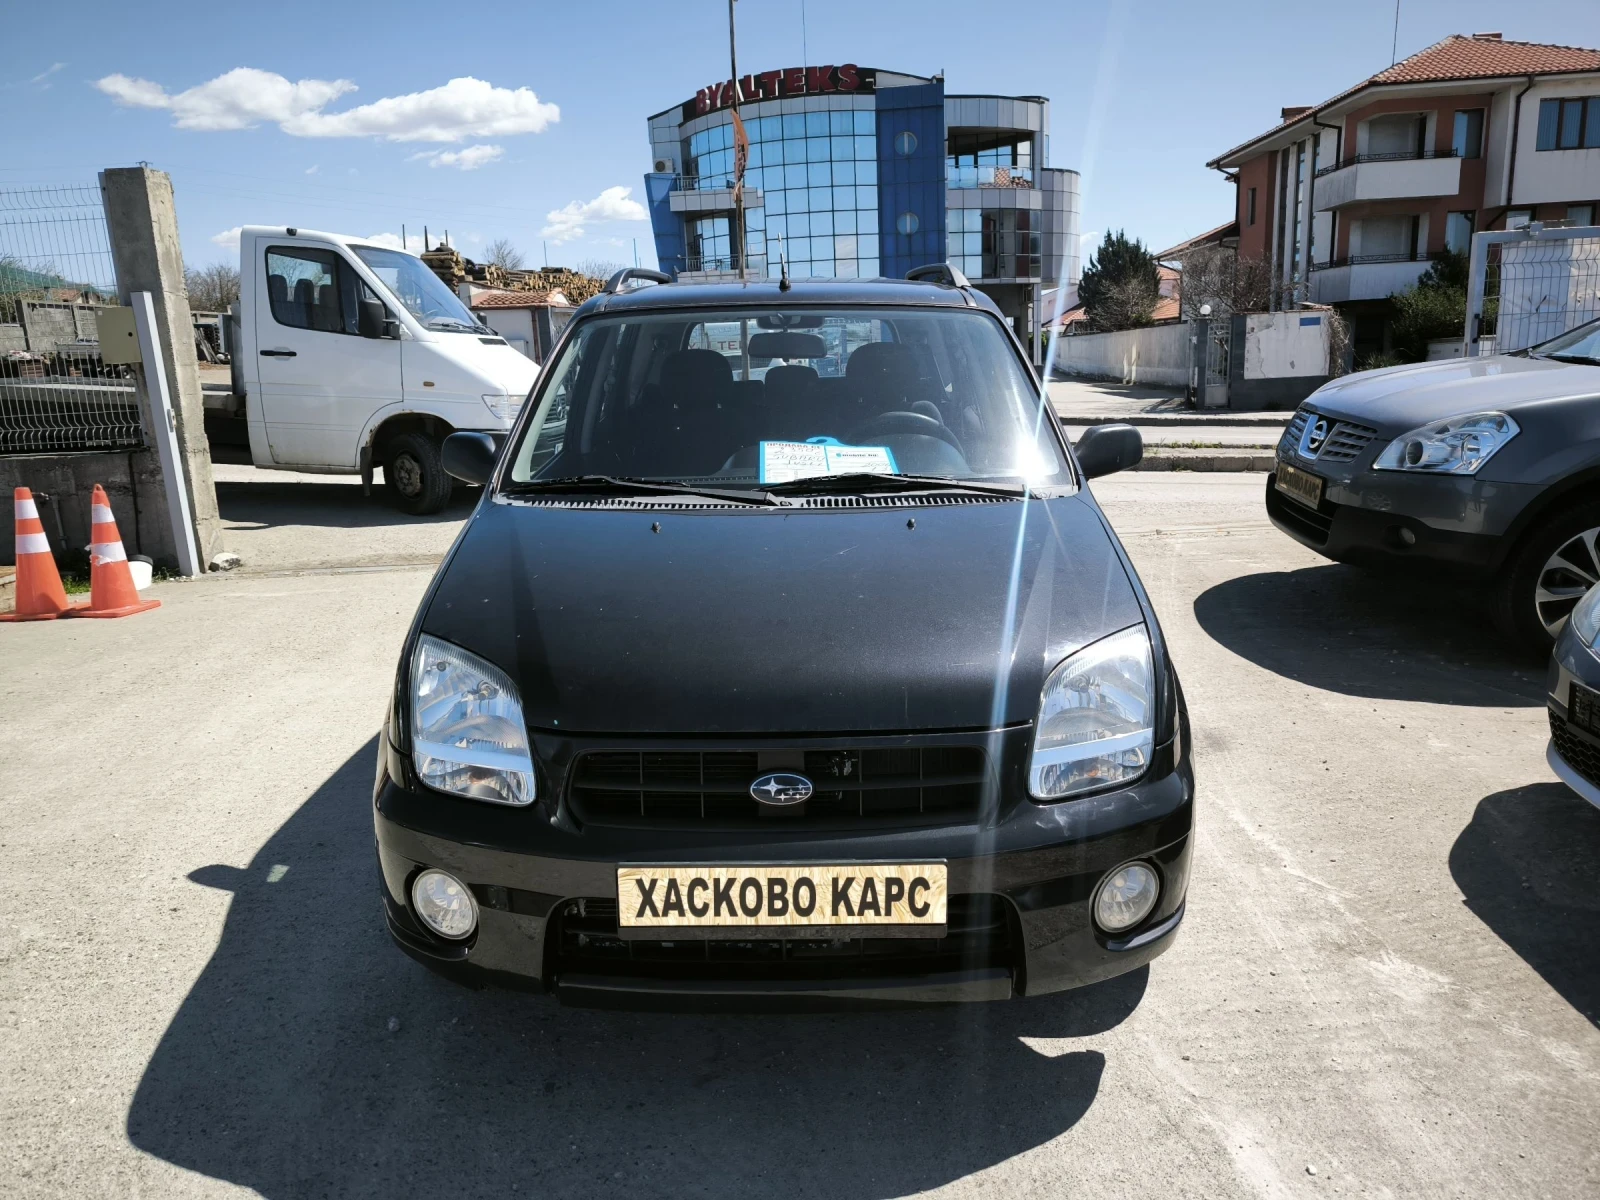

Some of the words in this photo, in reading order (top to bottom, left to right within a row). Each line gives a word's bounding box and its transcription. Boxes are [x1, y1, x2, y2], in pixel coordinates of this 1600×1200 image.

[696, 63, 860, 117] BYALTEKS
[635, 876, 817, 918] ХАСКОВО
[831, 876, 931, 918] КАРС
